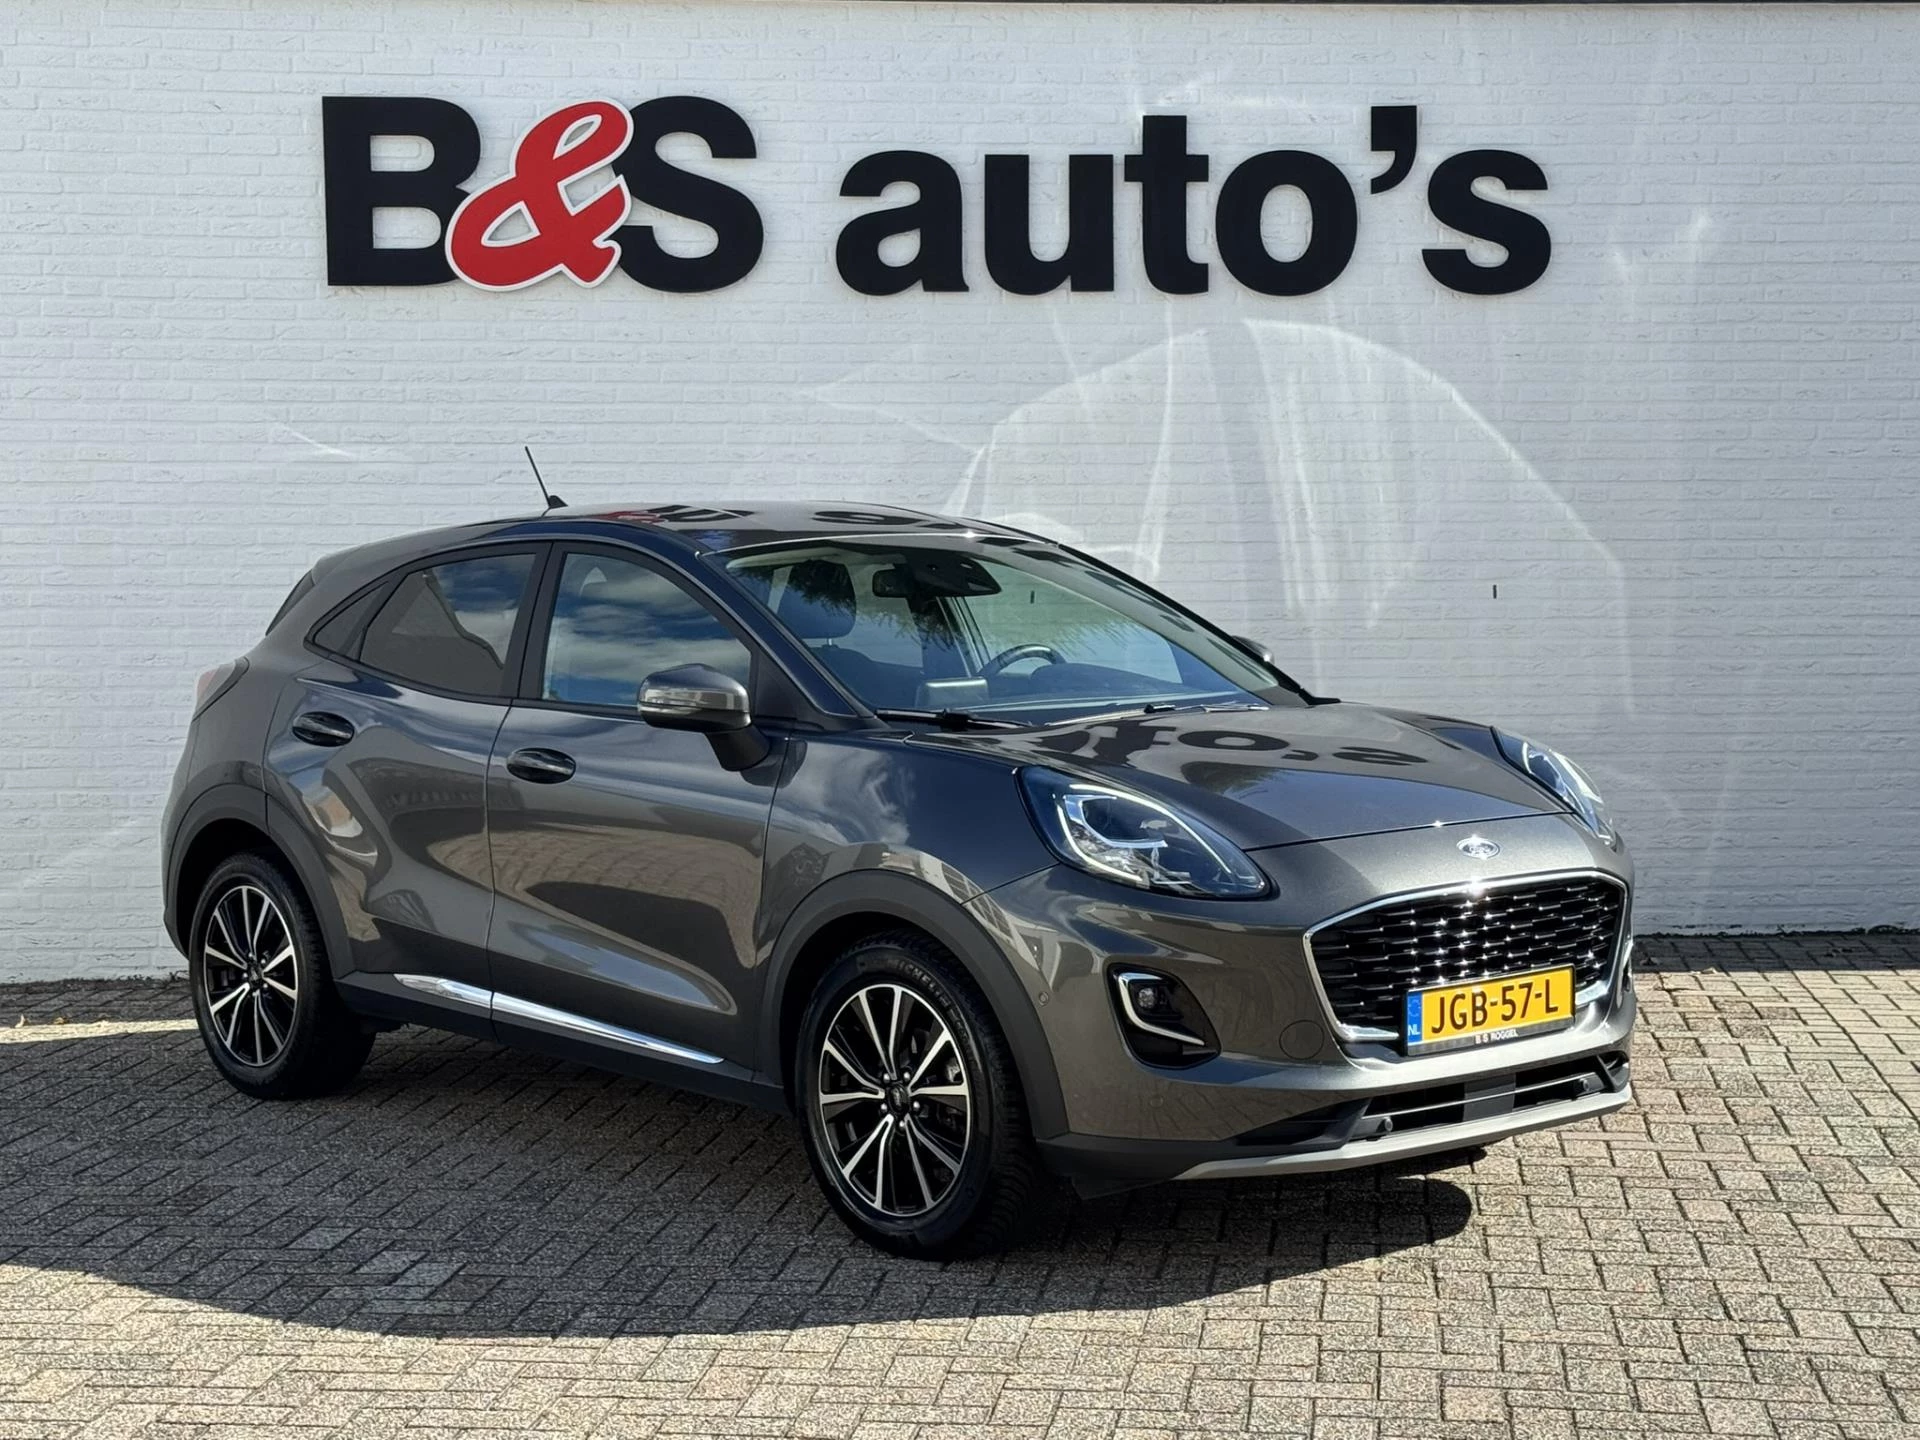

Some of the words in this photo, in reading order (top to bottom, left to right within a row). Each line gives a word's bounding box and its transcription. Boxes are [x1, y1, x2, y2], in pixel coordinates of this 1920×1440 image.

[321, 95, 764, 294] B&S
[836, 105, 1552, 297] auto's
[1407, 1026, 1420, 1037] NL
[1431, 978, 1559, 1034] JGB-57-L
